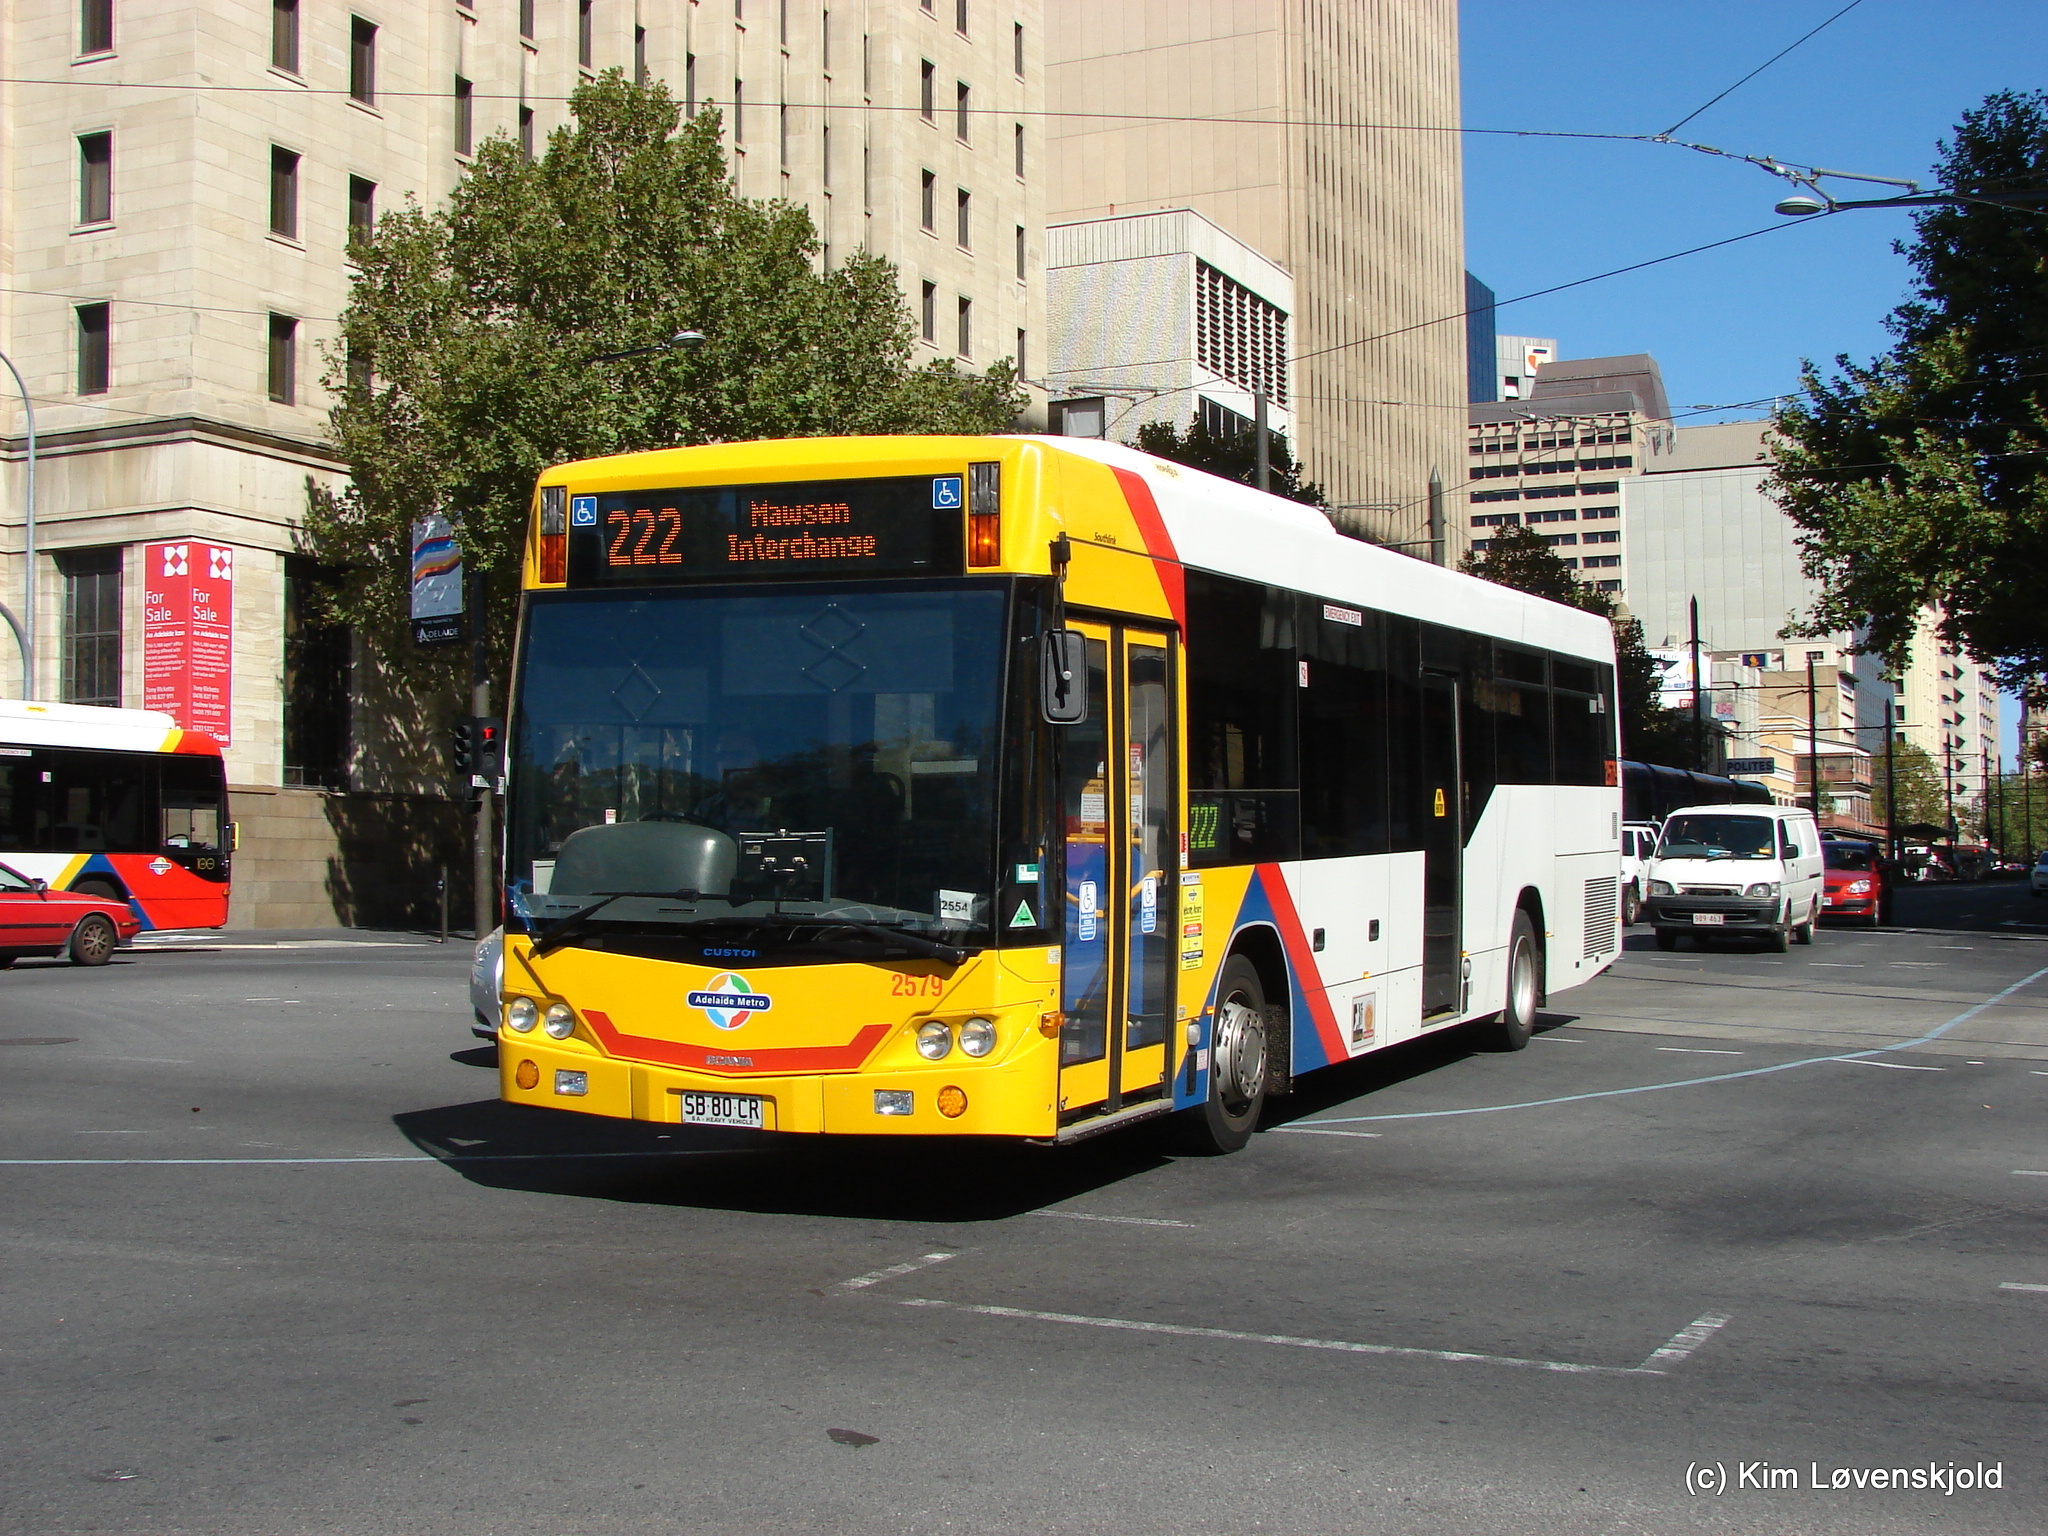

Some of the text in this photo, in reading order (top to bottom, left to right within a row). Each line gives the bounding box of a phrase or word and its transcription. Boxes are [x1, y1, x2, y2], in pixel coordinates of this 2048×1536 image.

[751, 500, 850, 527] Mawson
[607, 506, 682, 566] 222
[727, 531, 876, 561] Interchange
[146, 591, 164, 604] For
[192, 588, 210, 603] For
[146, 606, 172, 622] Sale
[192, 606, 217, 622] Sale
[416, 628, 458, 642] ADELAIDE
[213, 733, 229, 742] Frank
[1727, 761, 1772, 771] POLITES
[1190, 804, 1218, 848] 222
[940, 900, 968, 912] 2554
[892, 974, 942, 996] 2579
[696, 995, 764, 1006] Adelaide Metro
[706, 1055, 754, 1067] SCANIA
